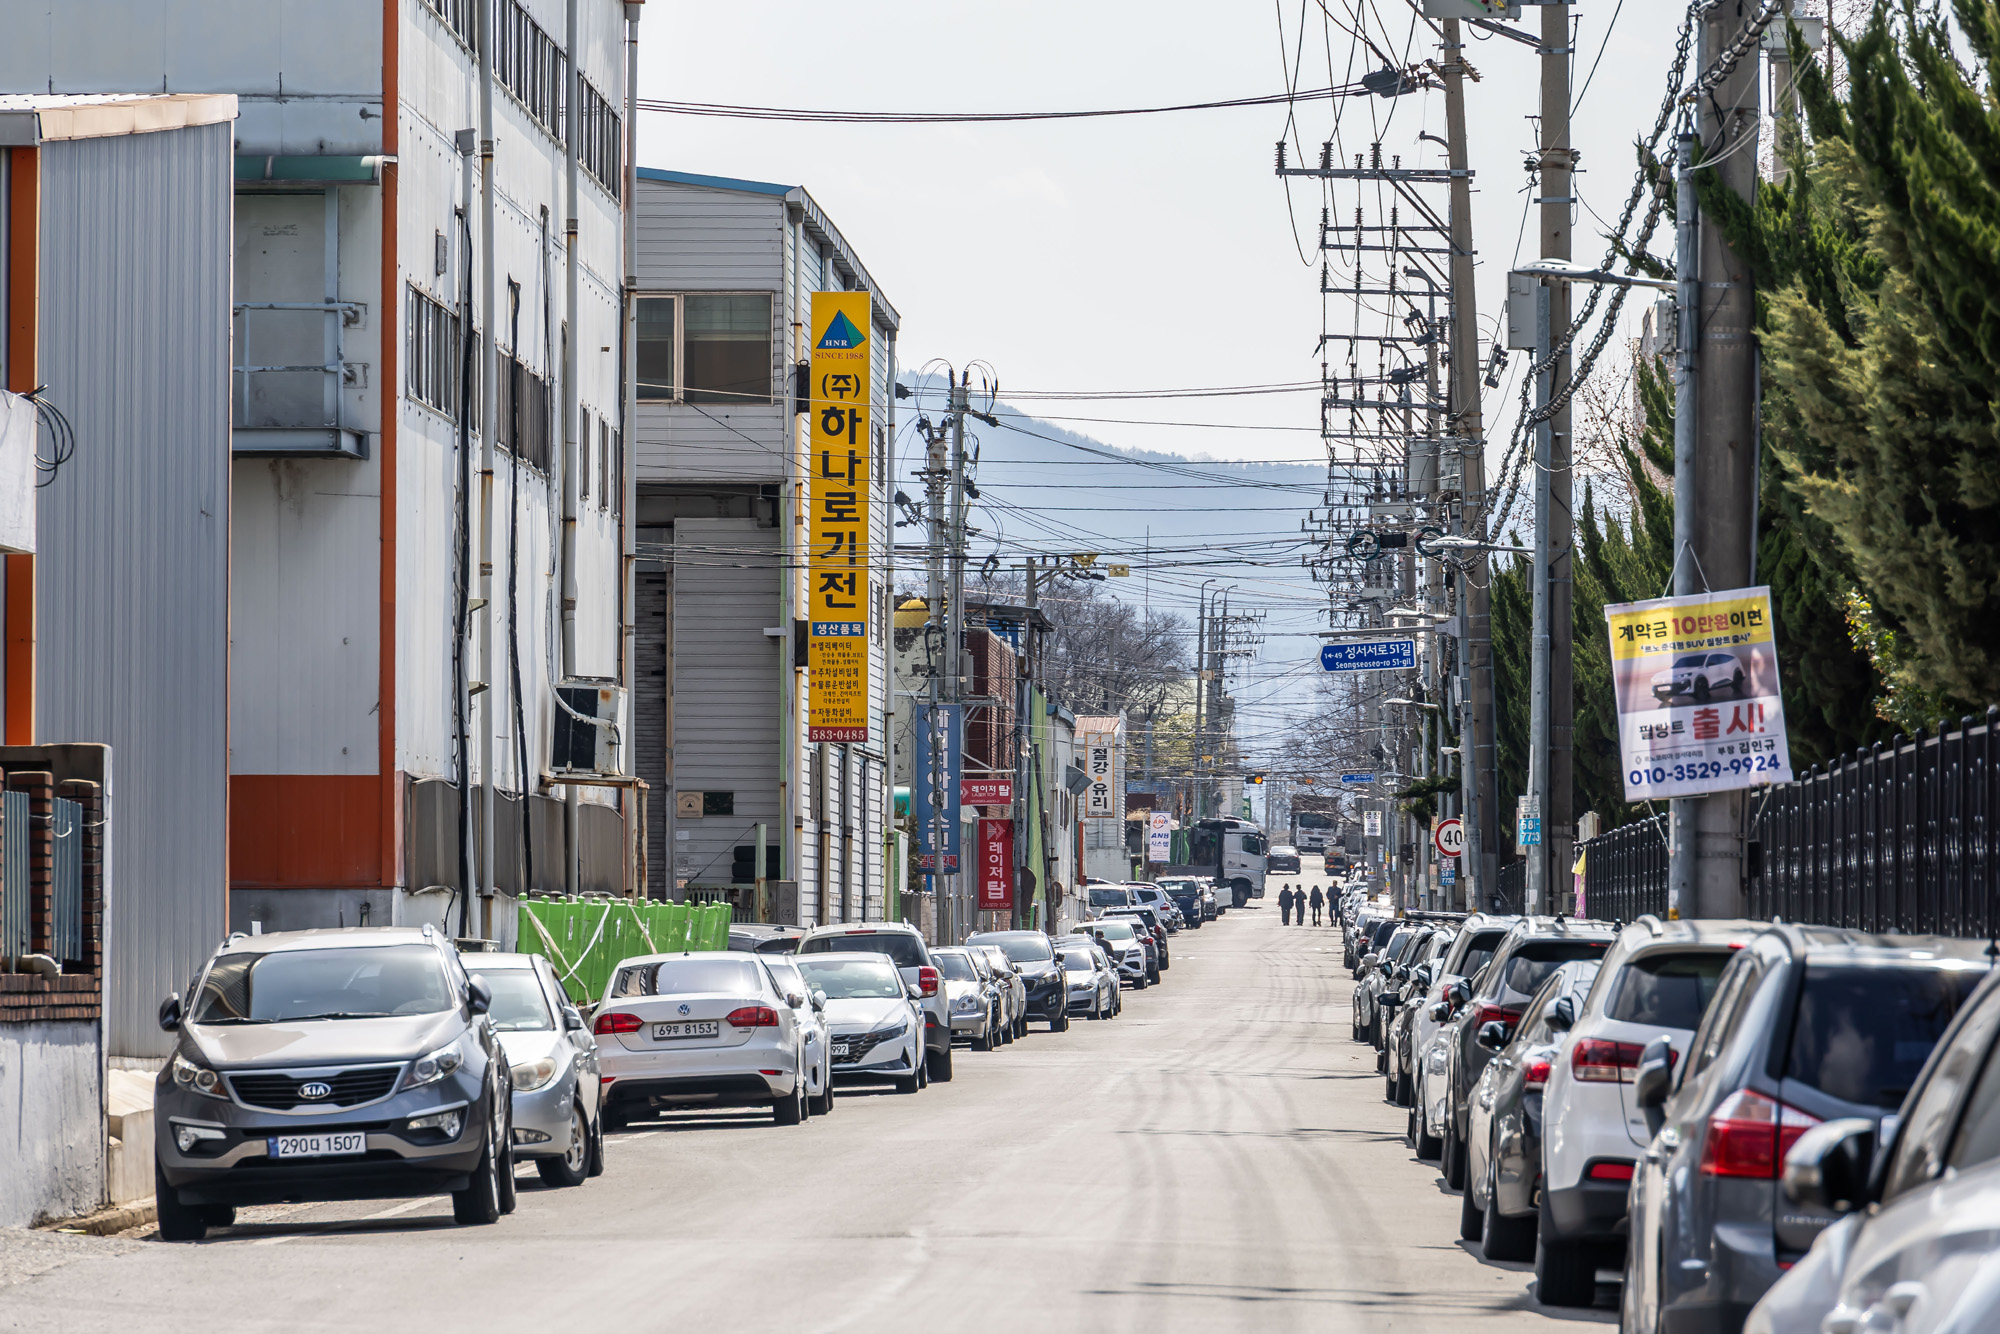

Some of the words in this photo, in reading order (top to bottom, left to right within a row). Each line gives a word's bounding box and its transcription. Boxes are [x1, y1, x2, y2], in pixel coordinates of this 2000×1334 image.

[824, 339, 848, 347] HNR
[815, 351, 844, 360] SINCE
[845, 352, 864, 360] 1988
[817, 623, 862, 635] 생산품목
[1618, 621, 1668, 642] 계약금
[1672, 609, 1762, 636] 10만원이면
[1686, 639, 1705, 648] SUV
[1335, 660, 1391, 670] Seongseoseo-ro
[1392, 658, 1412, 667] 51-gil
[818, 667, 859, 678] 주차설비일체
[818, 679, 859, 689] 물류운반설비
[817, 707, 852, 717] 자동화설비
[1639, 720, 1686, 740] 필랑트
[1692, 703, 1765, 740] 출시!
[812, 729, 864, 740] 583-0485
[1091, 735, 1112, 746] ACE
[1738, 739, 1775, 754] 김인규
[1629, 754, 1780, 786] 010-3529-9924
[971, 785, 996, 793] 레이저
[998, 784, 1010, 796] 탑
[1444, 829, 1463, 846] 40
[989, 842, 1003, 878] 레이저
[987, 880, 1006, 900] 탑
[659, 1025, 680, 1036] 69무
[684, 1023, 712, 1034] 8153
[302, 1085, 327, 1097] KIA
[325, 1135, 362, 1152] 1507
